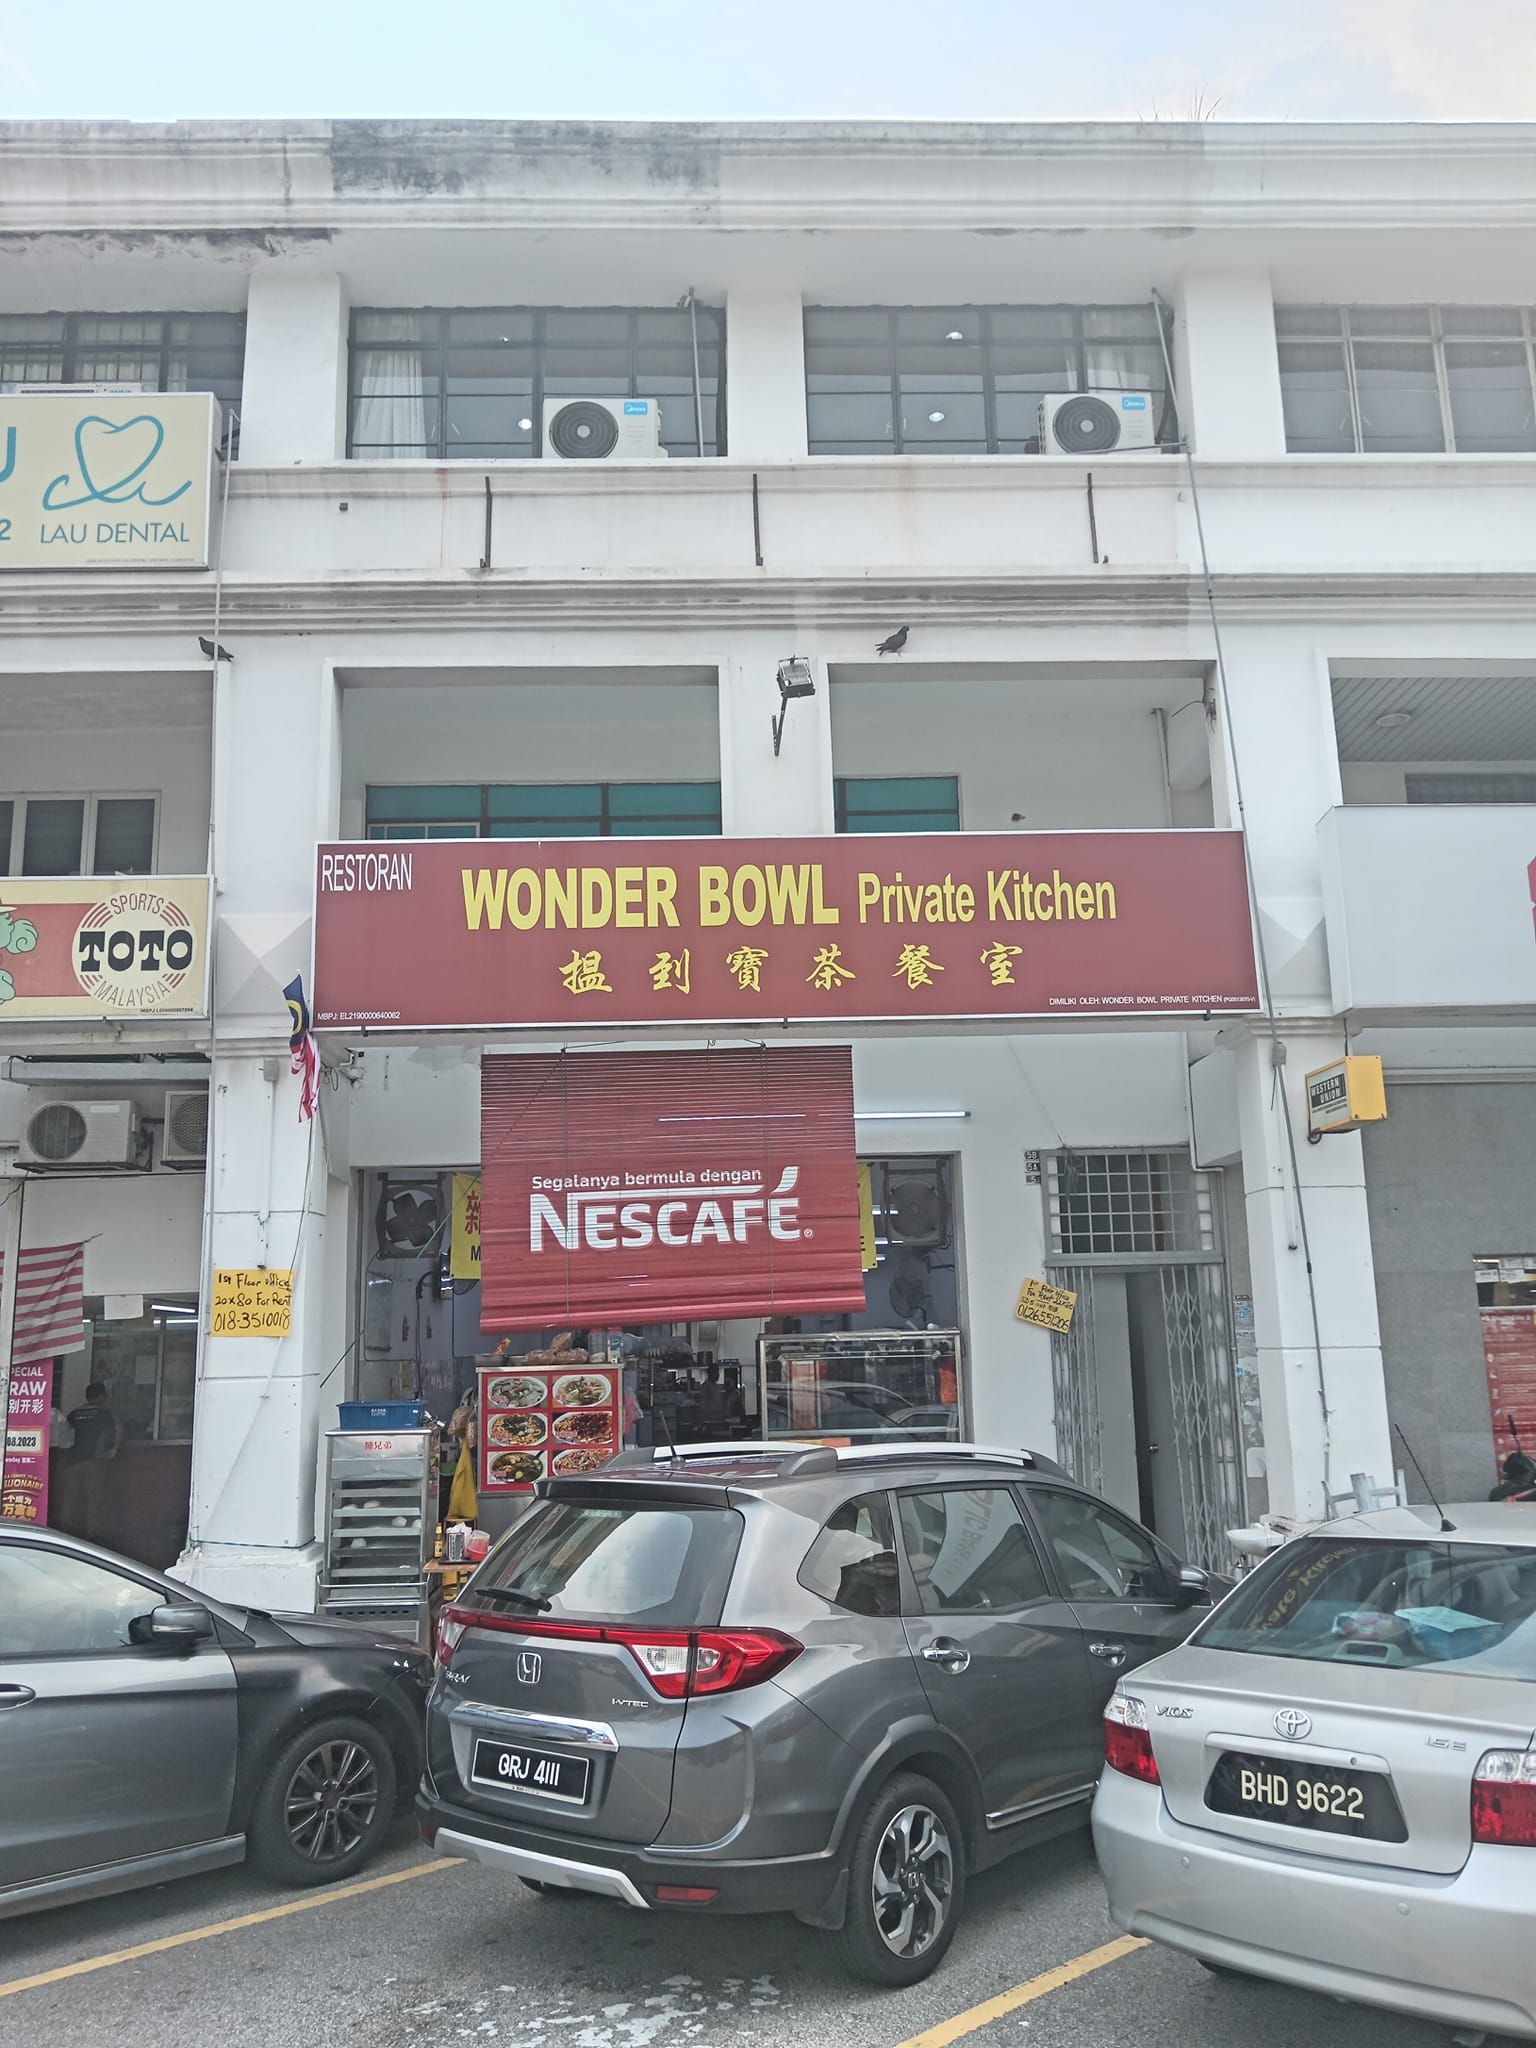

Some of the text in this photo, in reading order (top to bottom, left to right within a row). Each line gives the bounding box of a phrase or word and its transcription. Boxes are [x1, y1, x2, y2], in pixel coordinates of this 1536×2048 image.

[40, 522, 190, 544] LAU DENTAL
[321, 853, 413, 892] RESTORAN
[111, 892, 165, 915] SPORTS
[461, 863, 1117, 930] WONDER BOWL Private Kitchen
[79, 929, 193, 973] TOTO
[94, 980, 171, 1007] MALAYSIA
[1049, 997, 1077, 1006] DIMILIKI
[1101, 996, 1134, 1005] WONDER
[1136, 995, 1159, 1005] BOWL
[1160, 995, 1190, 1004] PRIVATE
[1191, 994, 1222, 1004] KITCHEN
[1311, 1077, 1340, 1097] WESTERN
[1320, 1087, 1341, 1104] UNION
[532, 1168, 762, 1192] Segalanya bermula dengan
[236, 1273, 262, 1288] Floor
[256, 1291, 271, 1306] For
[272, 1292, 292, 1306] Rent
[498, 1753, 561, 1787] QRJ 4111
[1240, 1769, 1365, 1819] BHD 9622
